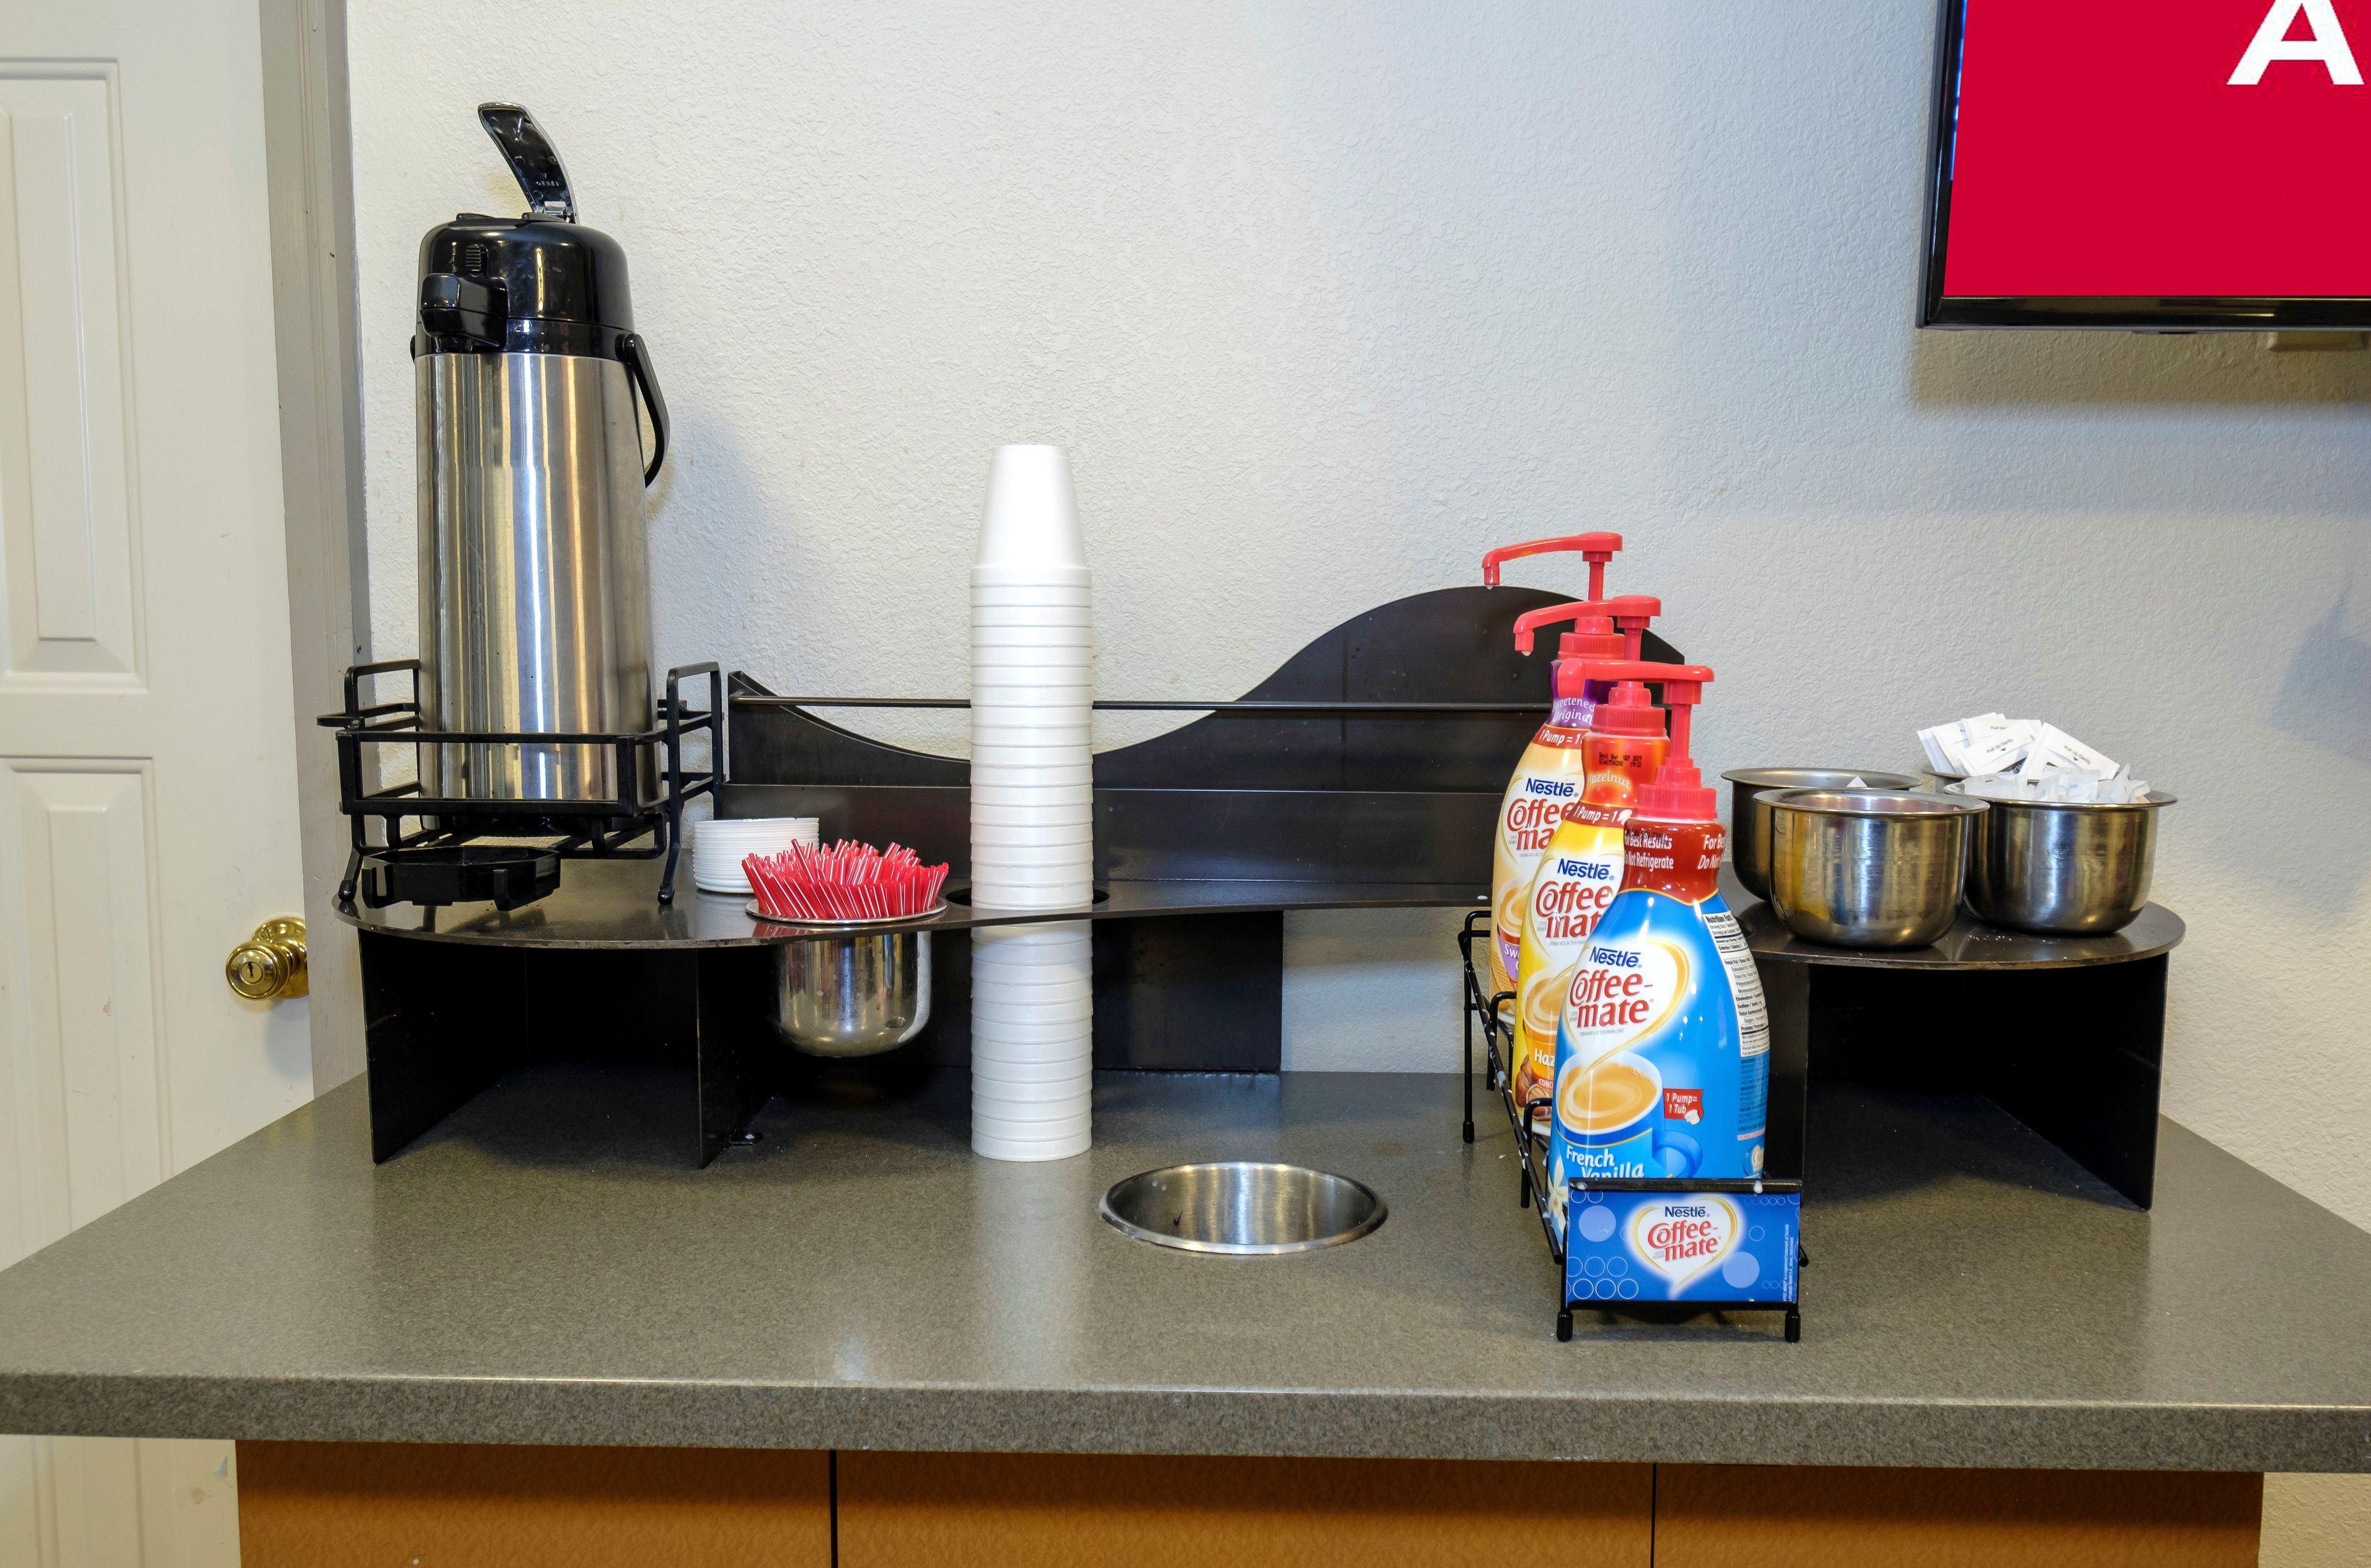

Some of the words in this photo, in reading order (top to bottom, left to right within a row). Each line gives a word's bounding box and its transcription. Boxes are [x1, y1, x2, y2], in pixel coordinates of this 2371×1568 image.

[2227, 0, 2365, 85] A
[1542, 730, 1565, 746] Pump
[1577, 806, 1602, 824] Pump
[1630, 832, 1642, 848] Best
[1643, 832, 1673, 849] Results
[1704, 834, 1717, 849] For
[1636, 851, 1674, 872] Refrigerate
[1697, 854, 1710, 869] Do
[1577, 999, 1650, 1028] mate
[1666, 1093, 1670, 1103] 1
[1670, 1104, 1673, 1114] 1
[1675, 1104, 1687, 1114] Tub
[1566, 1145, 1615, 1168] French
[1665, 1238, 1718, 1262] mate
